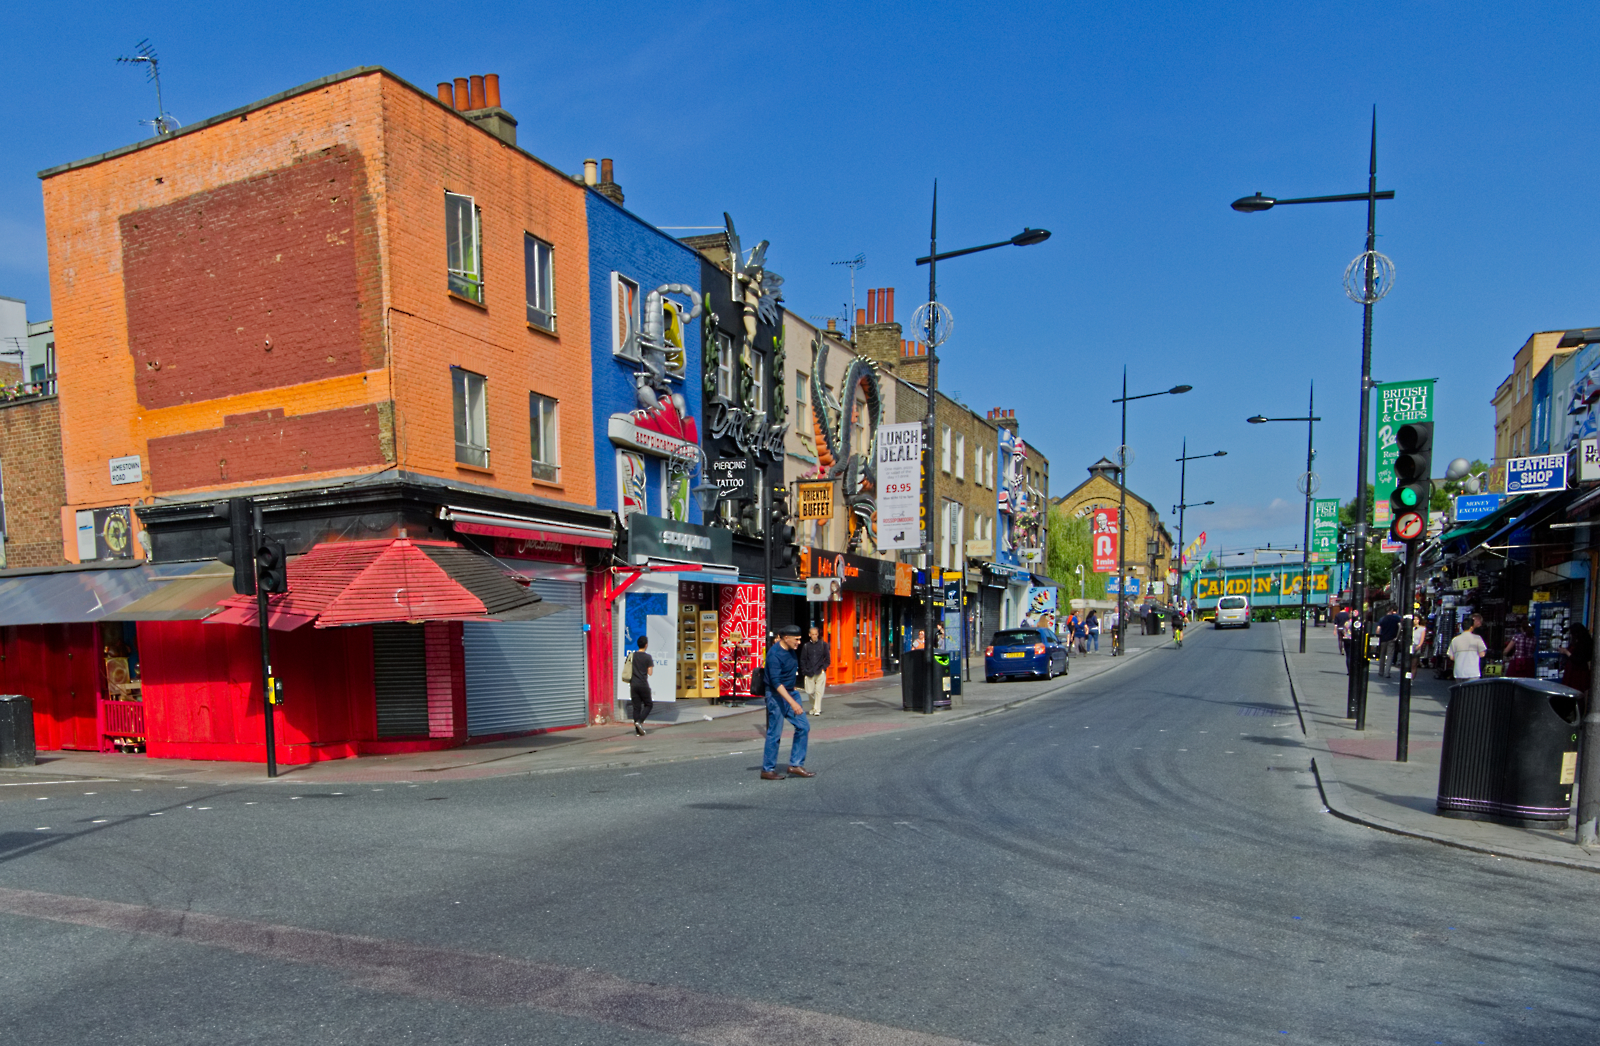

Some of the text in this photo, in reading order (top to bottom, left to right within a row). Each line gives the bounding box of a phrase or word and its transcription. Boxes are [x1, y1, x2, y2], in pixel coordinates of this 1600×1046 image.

[1383, 386, 1427, 398] BRITISH
[1382, 396, 1427, 413] FISH
[1382, 410, 1427, 422] & CHIPS
[880, 430, 918, 446] LUNCH
[880, 445, 918, 463] DEAL!
[112, 462, 140, 472] JAMESTOWN
[713, 461, 746, 470] PIERCING
[1510, 457, 1564, 472] LEATHER
[112, 474, 126, 482] ROAD
[716, 479, 744, 487] TATTOO
[1521, 470, 1554, 484] SHOP
[886, 482, 912, 493] £9.95
[802, 490, 830, 502] ORIENTAL
[802, 502, 830, 516] BUFFET
[1460, 506, 1497, 514] EXCHANGE
[662, 530, 712, 552] scorpion
[1194, 573, 1328, 599] CAMDEN LOCK
